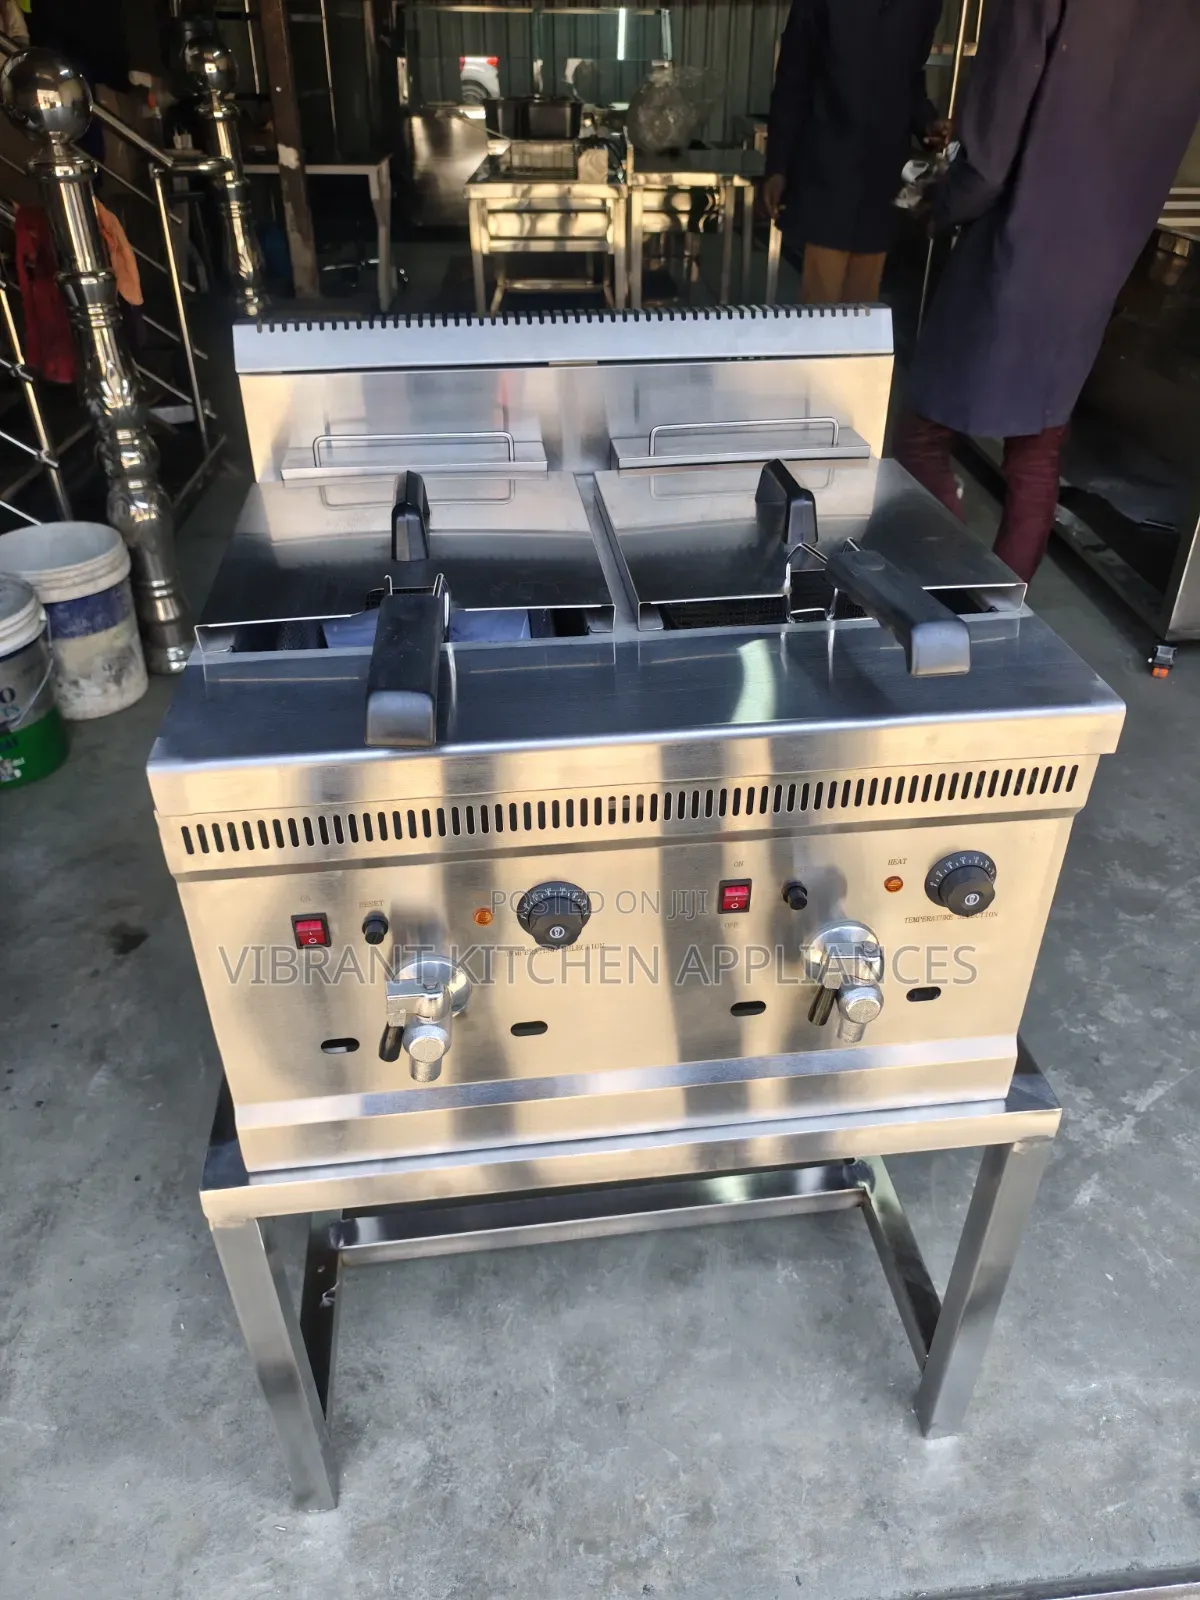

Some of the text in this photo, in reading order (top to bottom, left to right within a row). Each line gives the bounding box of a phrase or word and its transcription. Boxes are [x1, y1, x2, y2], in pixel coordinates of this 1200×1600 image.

[733, 860, 744, 868] ON
[887, 858, 907, 866] HEAT
[904, 914, 954, 924] TEMPERATURE
